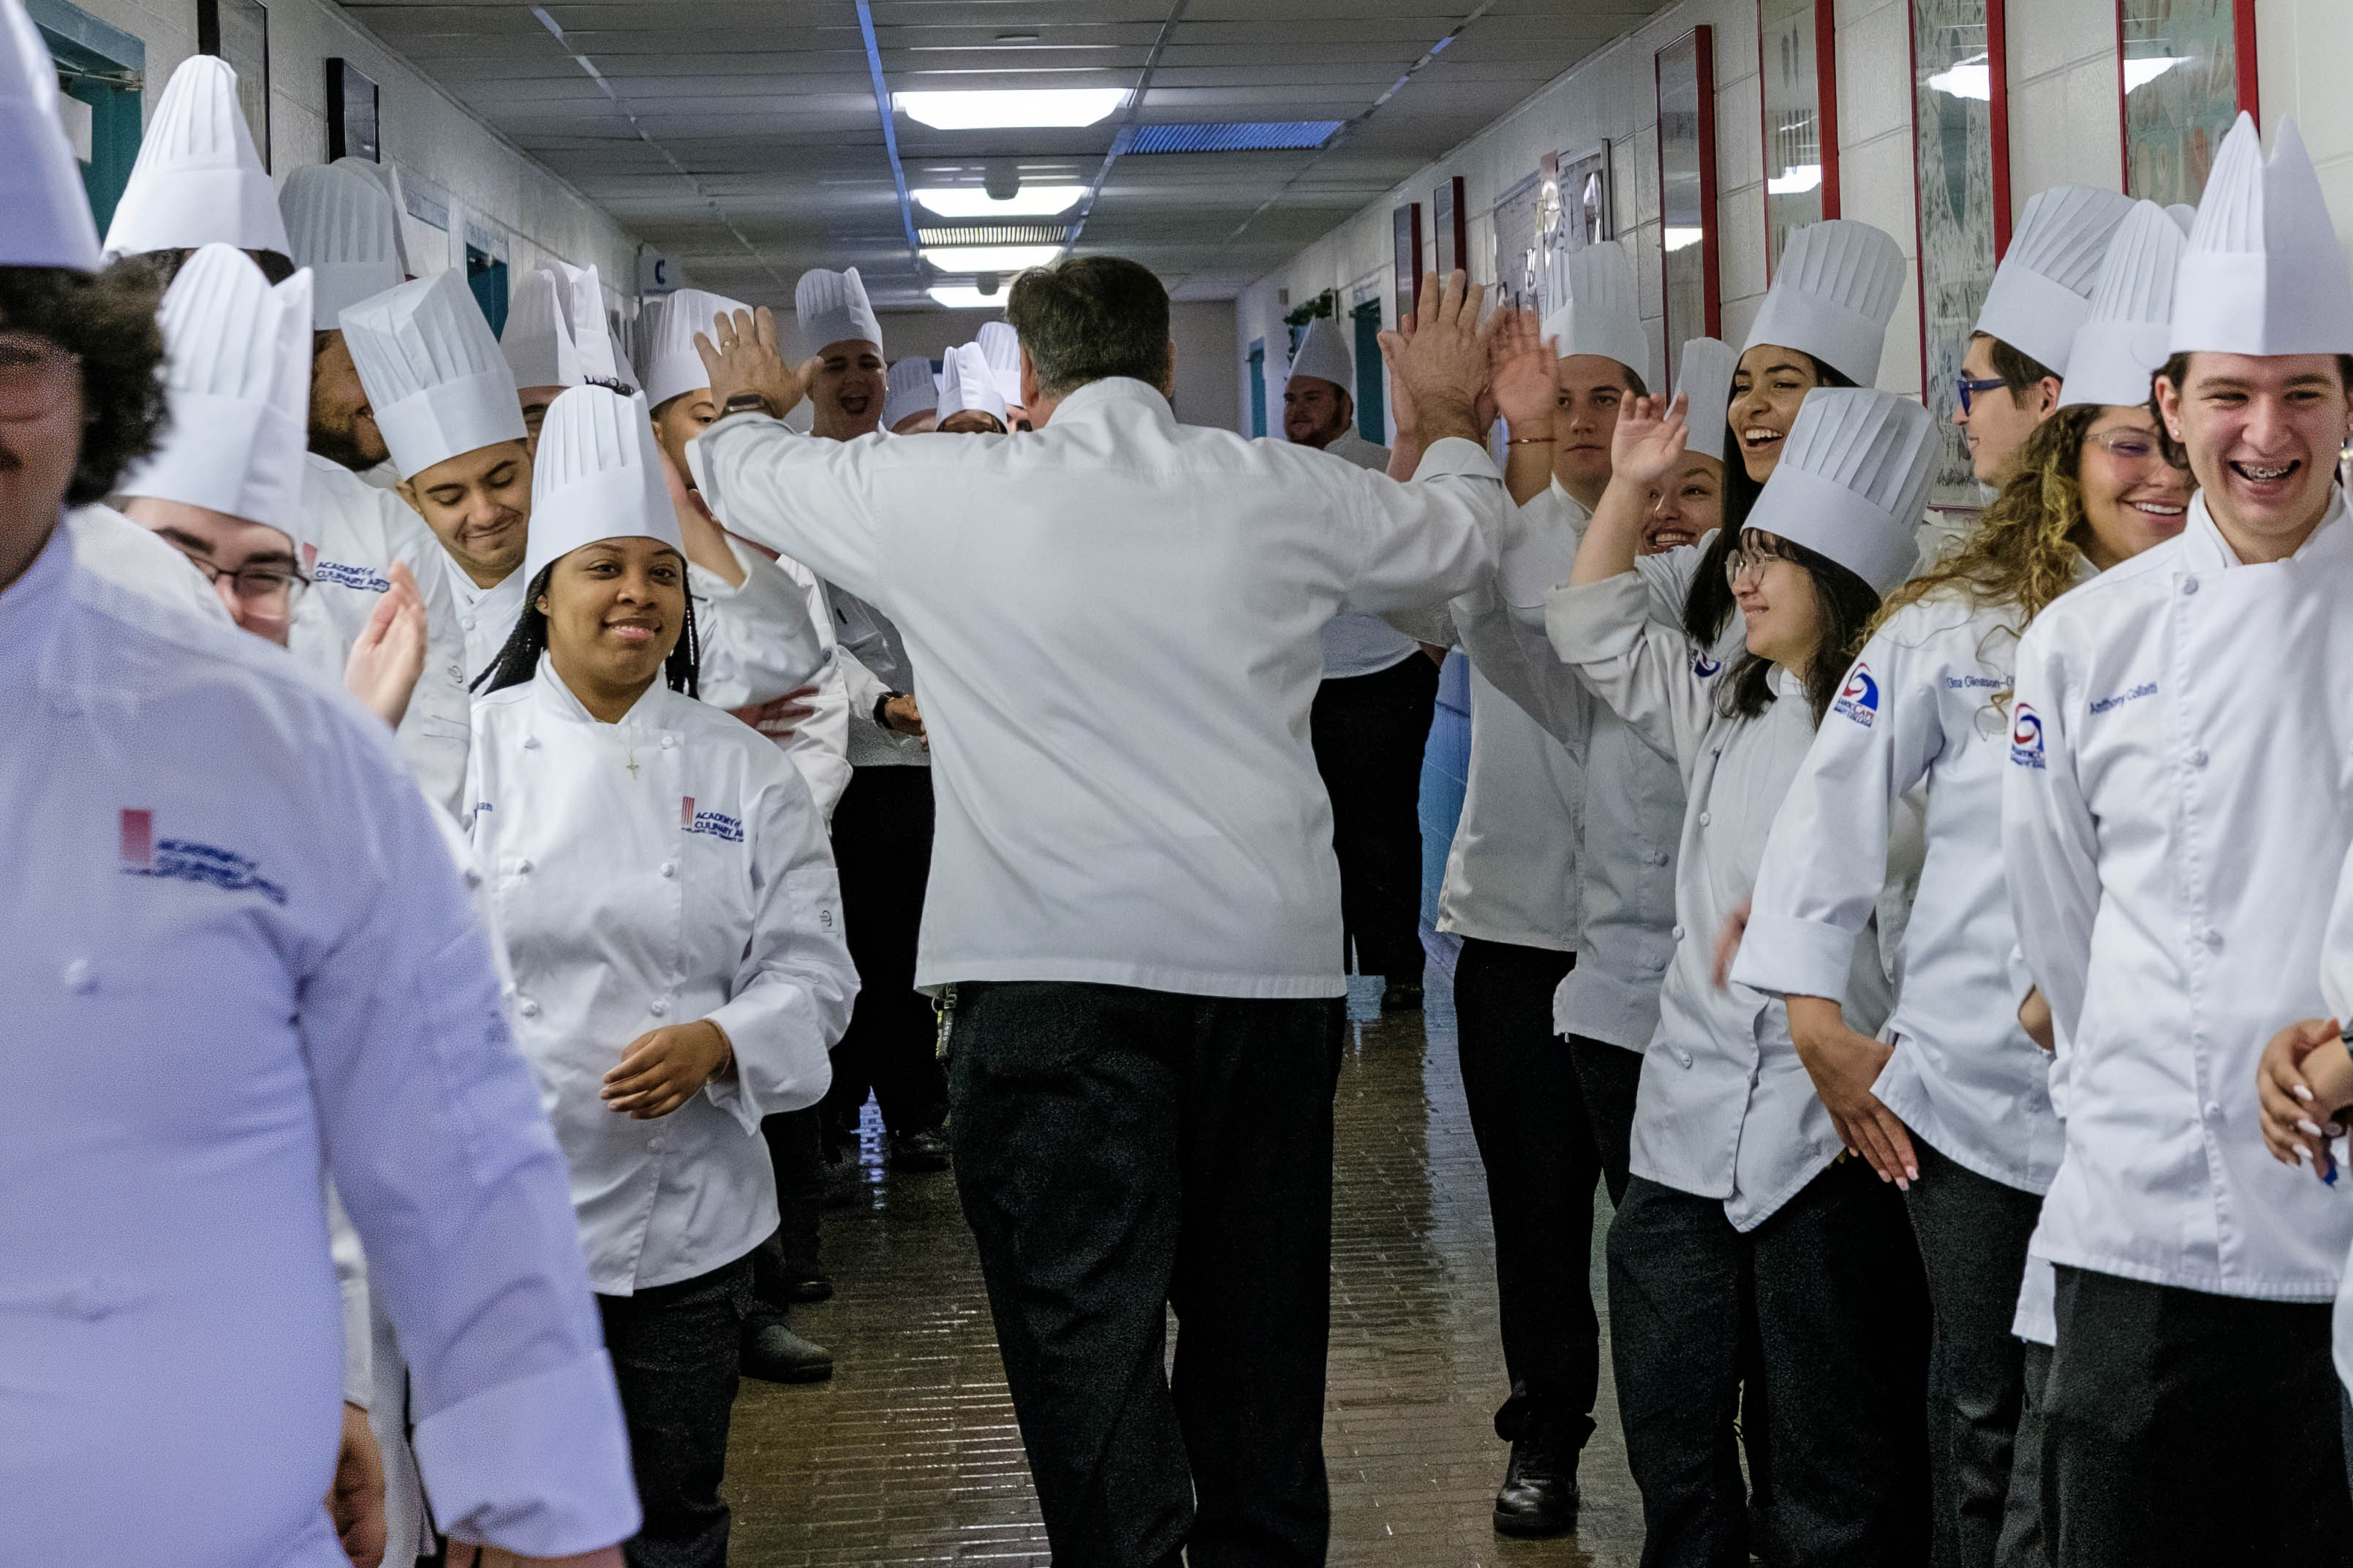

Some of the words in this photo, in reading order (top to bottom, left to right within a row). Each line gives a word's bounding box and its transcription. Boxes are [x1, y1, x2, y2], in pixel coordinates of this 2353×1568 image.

[316, 570, 367, 585] CULINARY
[695, 812, 736, 826] ACADEMY
[695, 821, 733, 836] CULINARY
